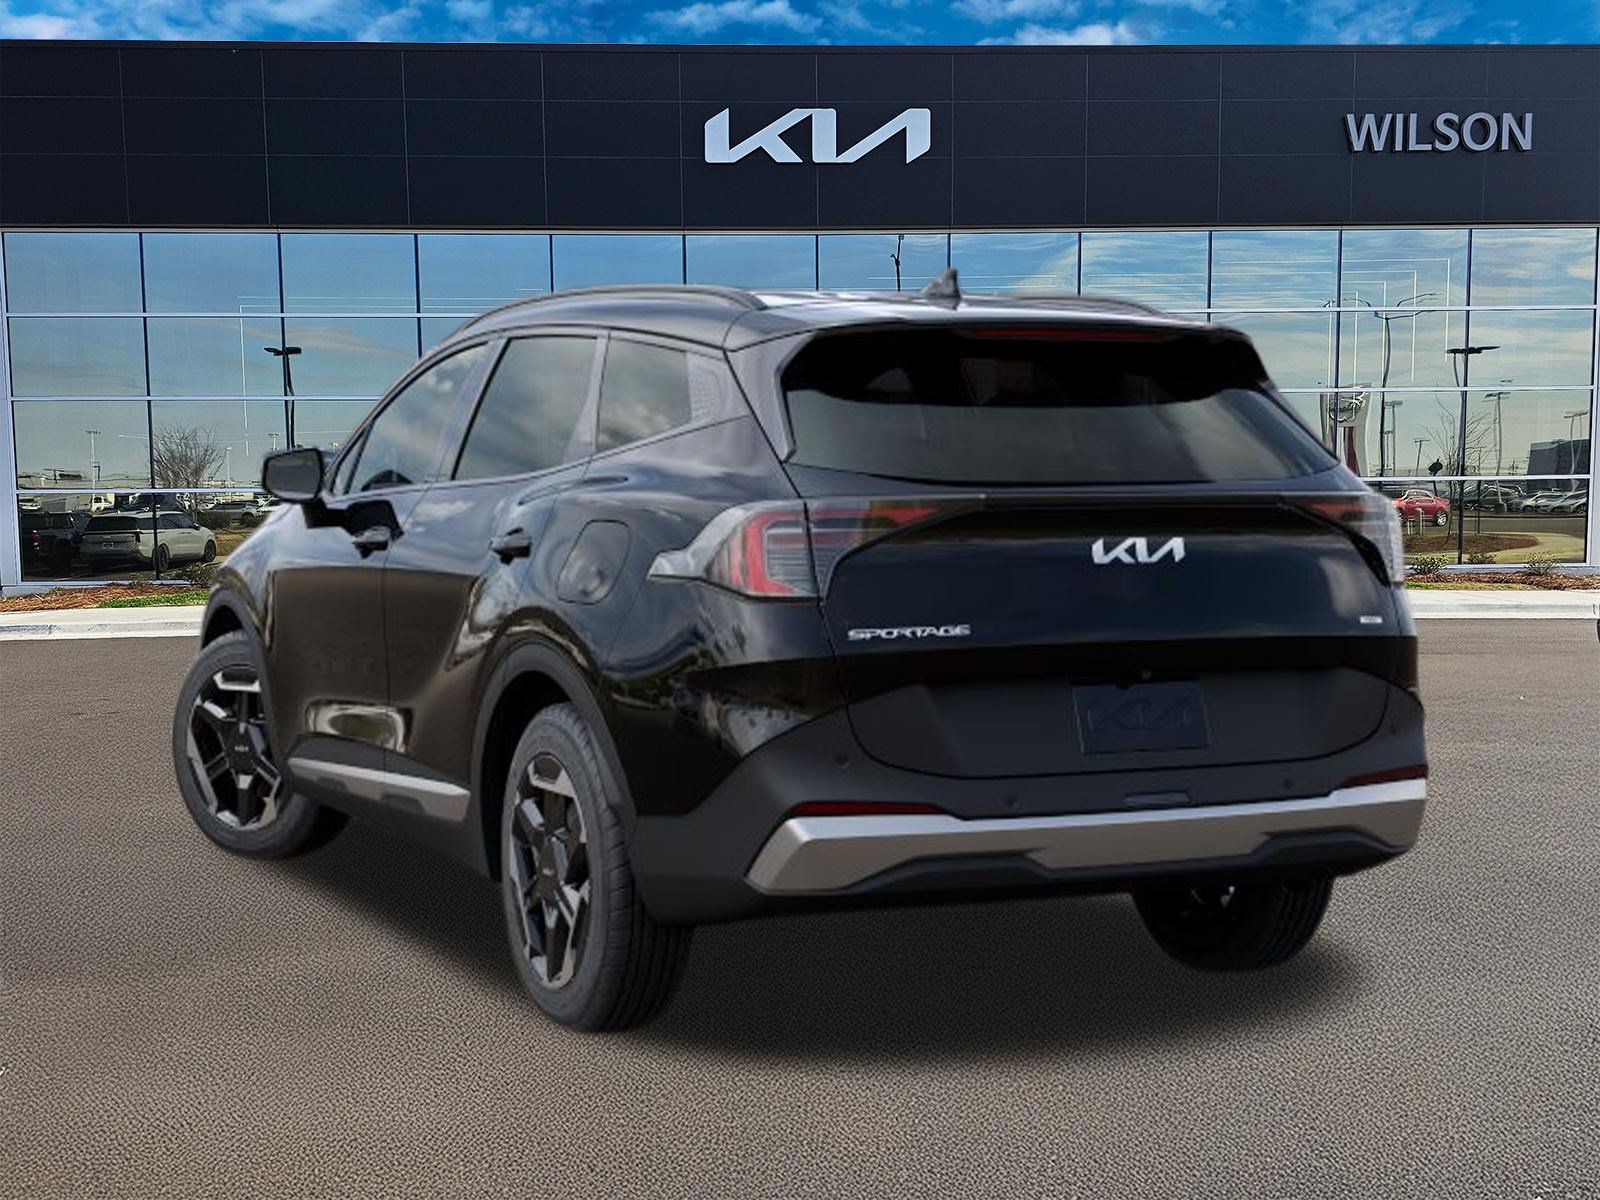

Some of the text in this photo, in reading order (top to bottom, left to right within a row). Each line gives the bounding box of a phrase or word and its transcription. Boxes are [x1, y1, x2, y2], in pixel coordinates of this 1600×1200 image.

[704, 107, 931, 164] KIA
[1345, 111, 1533, 152] WILSON
[1092, 536, 1185, 564] KIA
[847, 624, 971, 640] SPORTAGE
